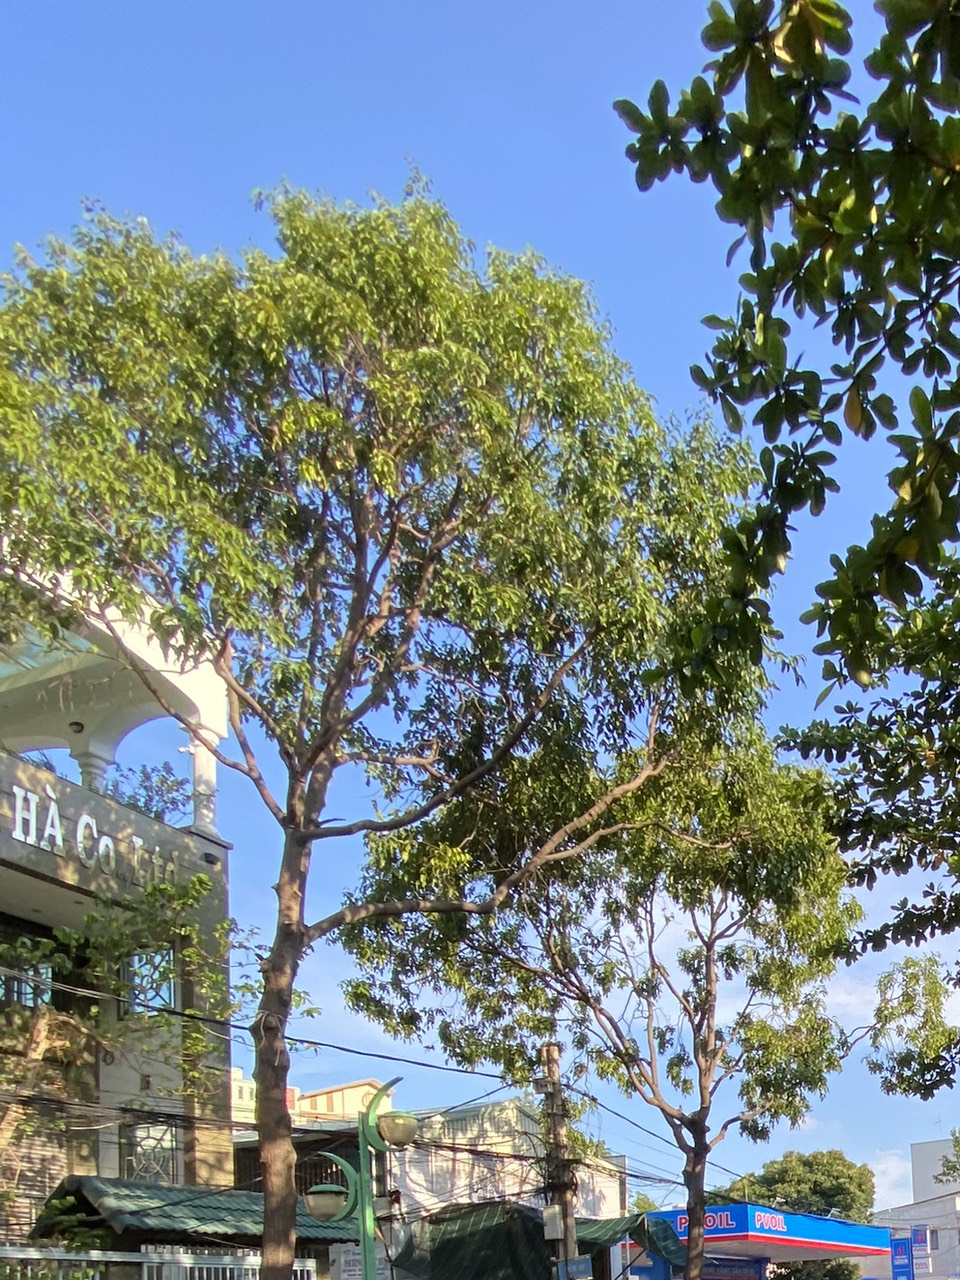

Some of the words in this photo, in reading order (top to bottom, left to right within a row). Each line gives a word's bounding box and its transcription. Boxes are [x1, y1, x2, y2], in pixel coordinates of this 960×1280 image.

[12, 784, 66, 857] HÀ
[77, 814, 117, 876] Co
[677, 1211, 735, 1231] POIL
[755, 1211, 787, 1232] PVOIL
